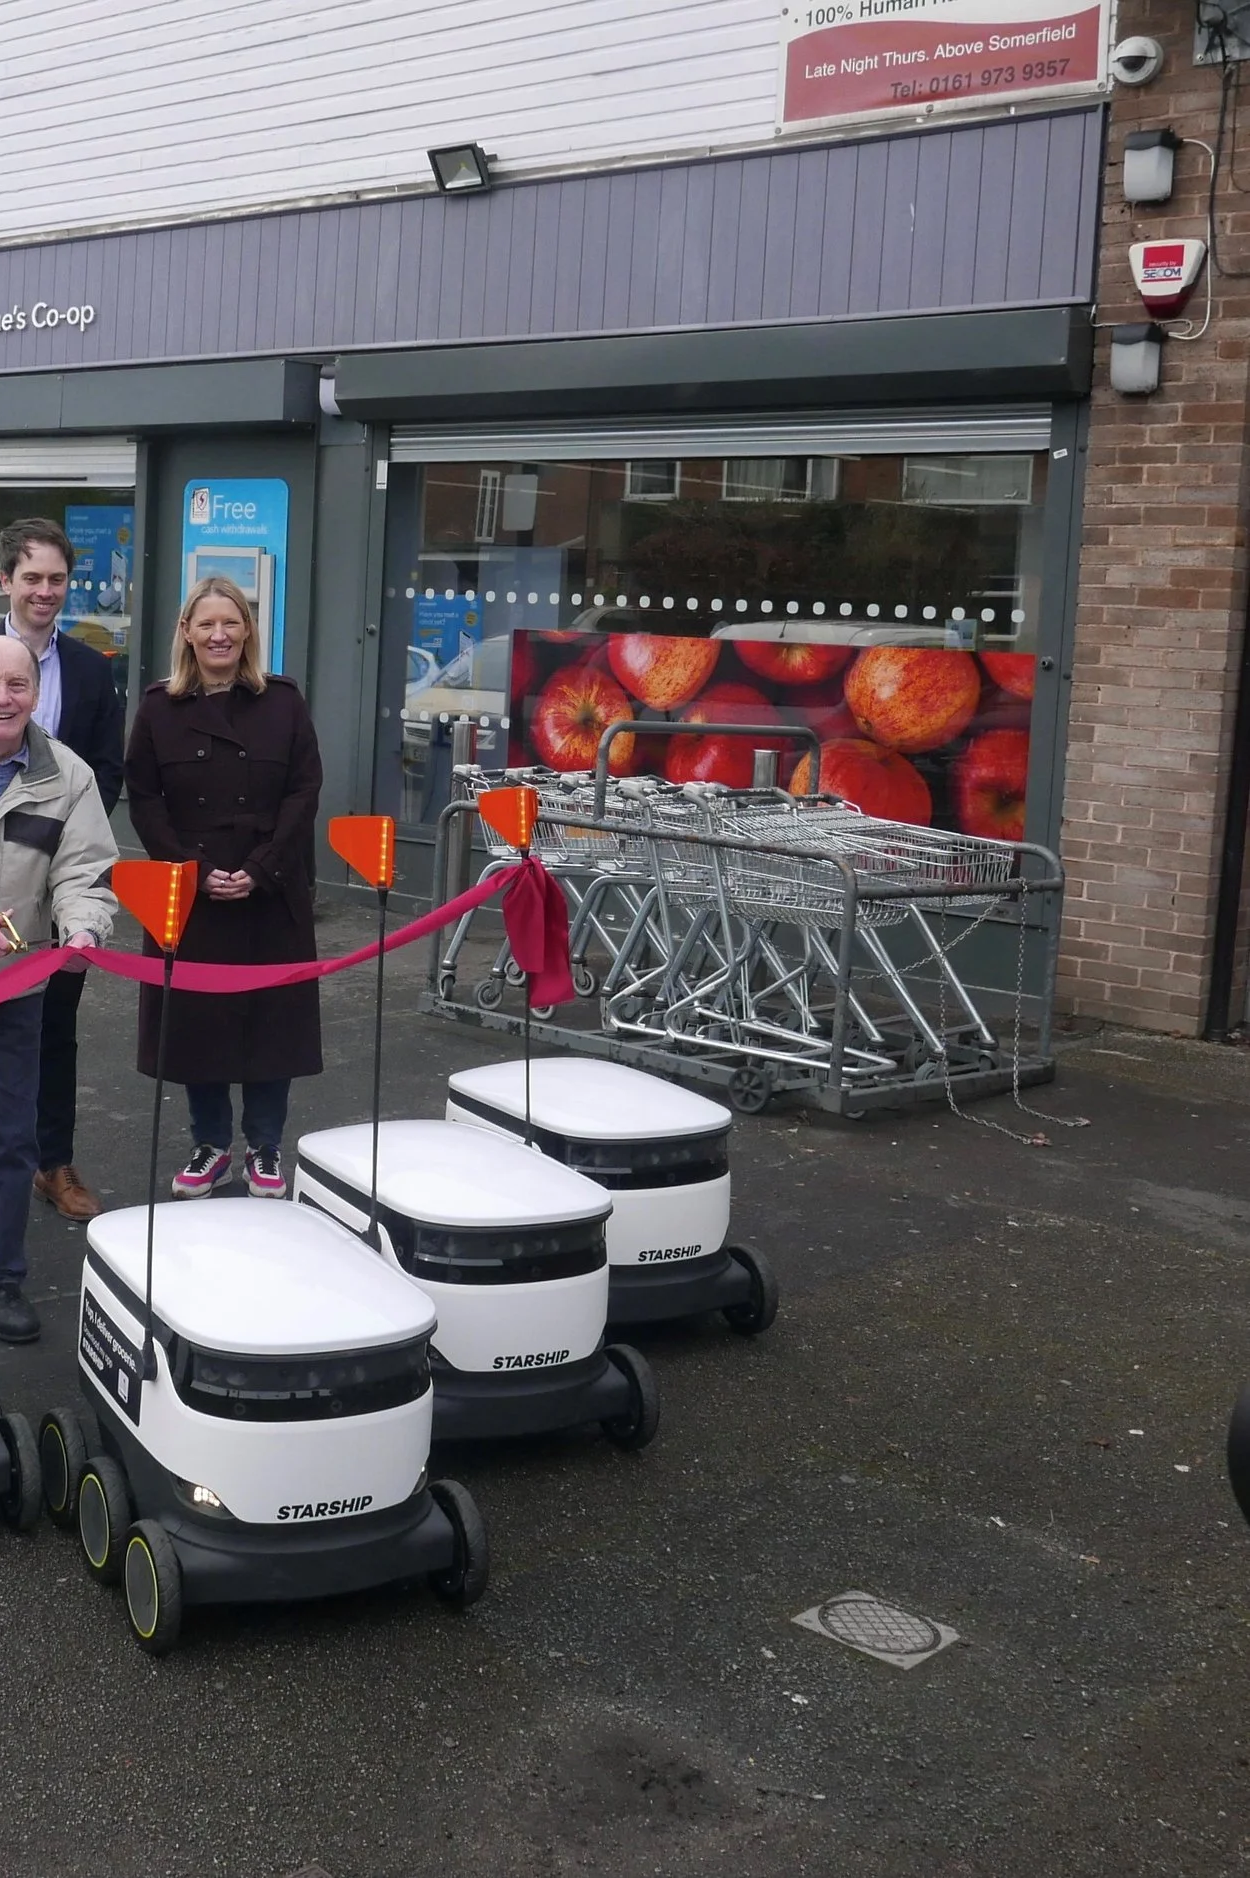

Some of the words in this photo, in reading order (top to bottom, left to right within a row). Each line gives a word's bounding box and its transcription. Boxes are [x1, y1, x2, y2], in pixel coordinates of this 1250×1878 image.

[805, 6, 853, 27] 100%
[859, 0, 925, 18] Human
[805, 62, 836, 79] Late
[841, 54, 879, 75] Night
[883, 49, 930, 68] Thurs.
[934, 40, 983, 60] Above
[988, 23, 1076, 52] Somerfield
[890, 79, 923, 99] Tel:
[929, 73, 973, 94] 0161
[980, 67, 1015, 87] 973
[1022, 57, 1071, 80] 9357
[1143, 267, 1181, 278] SECOM
[31, 301, 94, 332] Co-op
[213, 495, 256, 520] Free
[201, 524, 219, 535] cash
[221, 524, 268, 535] withdrawals
[638, 1244, 701, 1262] STARSHIP
[493, 1349, 570, 1370] STARSHIP
[277, 1495, 373, 1521] STARSHIP
